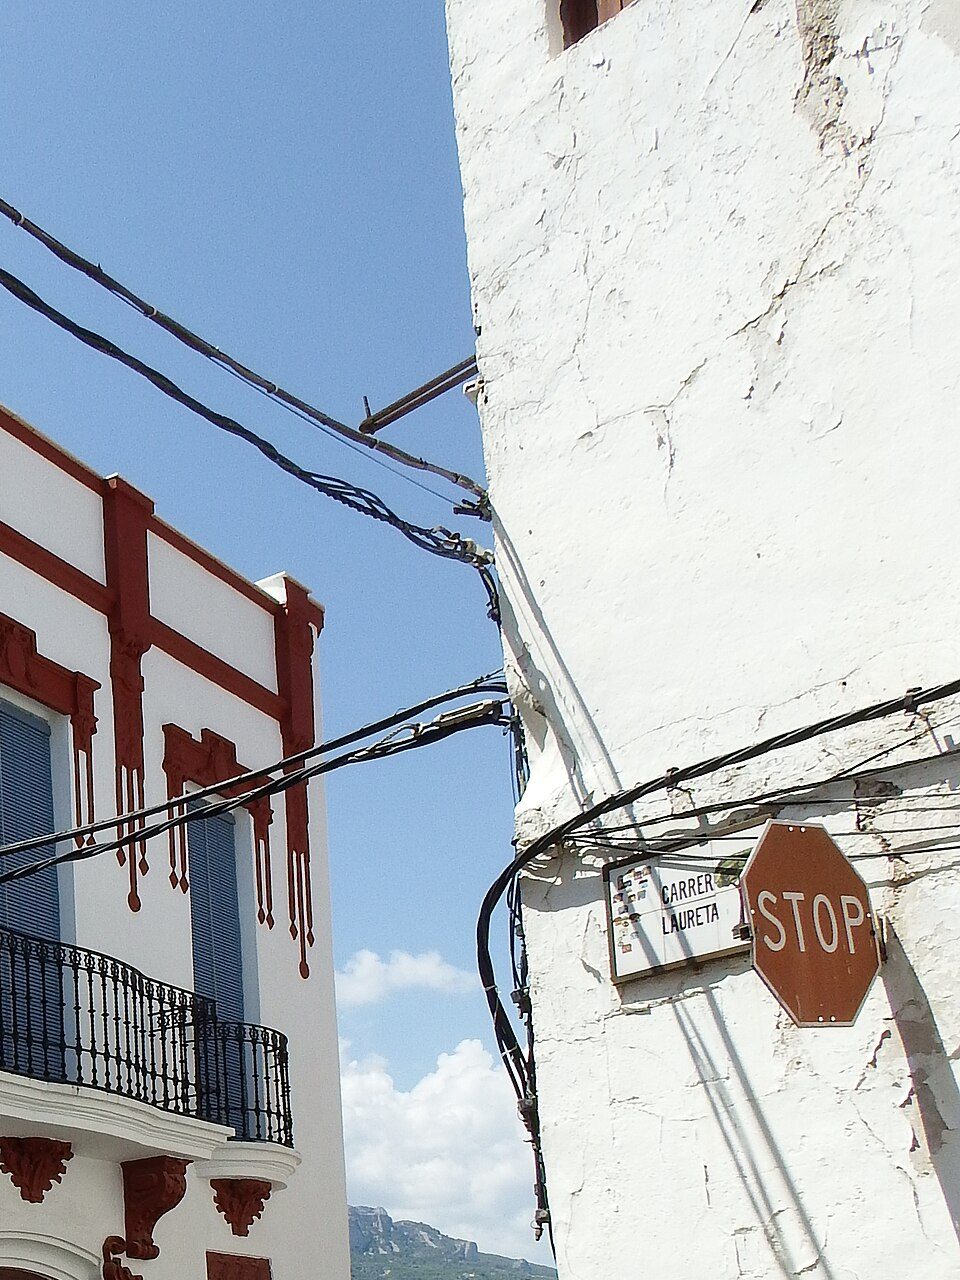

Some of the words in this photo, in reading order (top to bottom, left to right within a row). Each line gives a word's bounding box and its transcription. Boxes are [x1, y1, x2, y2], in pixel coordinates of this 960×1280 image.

[662, 873, 714, 905] CARRER
[662, 903, 719, 935] LAURETA
[757, 890, 864, 953] STOP
